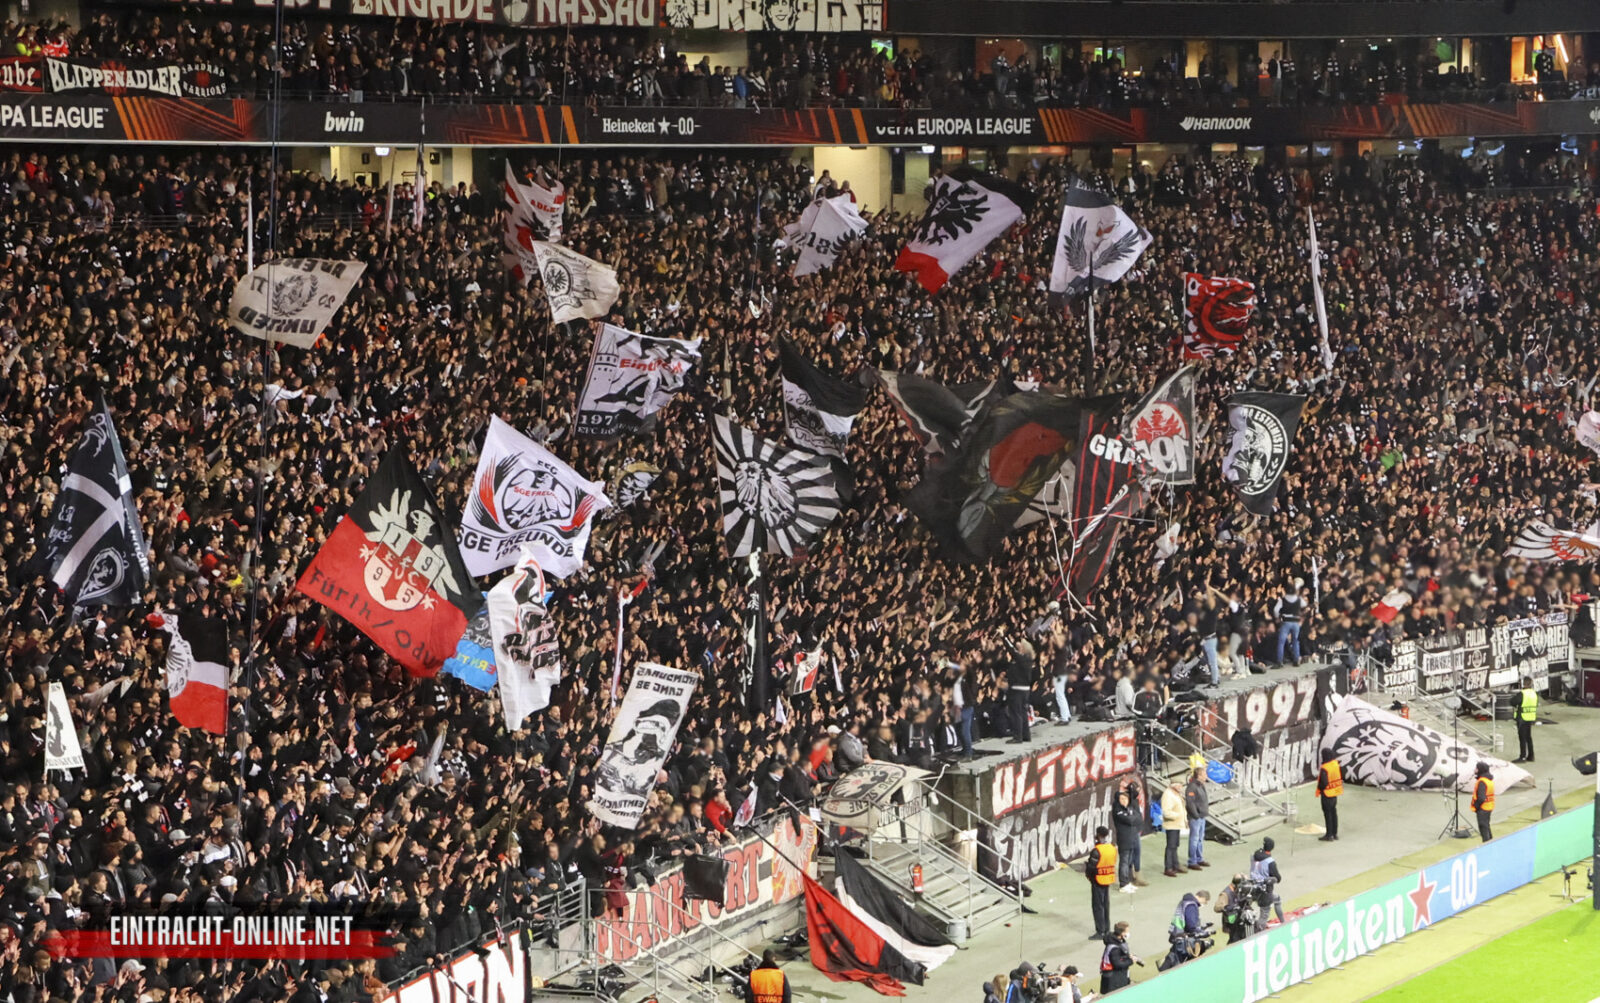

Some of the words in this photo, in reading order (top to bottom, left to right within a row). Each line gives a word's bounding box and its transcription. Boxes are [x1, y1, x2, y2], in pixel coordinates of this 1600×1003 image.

[46, 57, 182, 97] KLIPPENADLER
[1, 105, 27, 127] PA
[30, 106, 105, 129] LEAGUE
[324, 111, 365, 133] bwin
[602, 117, 656, 134] Heineken
[917, 118, 974, 135] EUROPA
[976, 118, 1031, 135] LEAGUE
[497, 531, 574, 558] FREUNDE
[1223, 676, 1318, 743] 1997
[993, 726, 1136, 819] ULTRAS
[992, 785, 1114, 882] Eintracht
[1242, 894, 1406, 1003] Heineken
